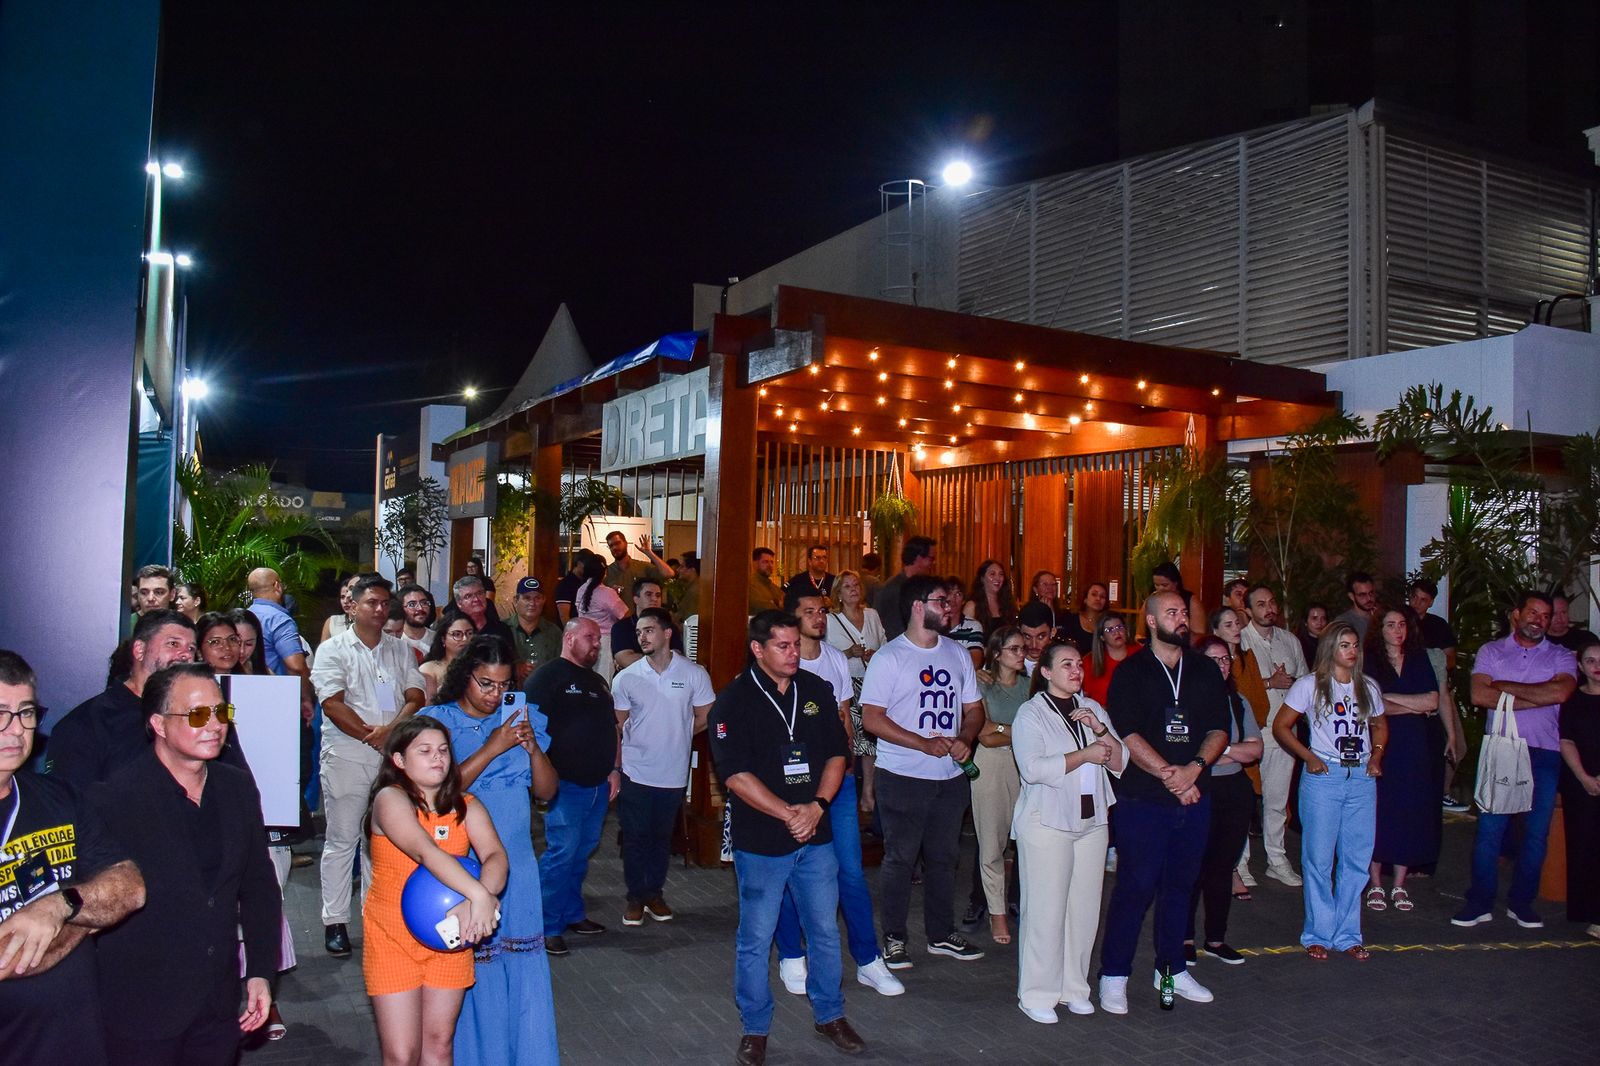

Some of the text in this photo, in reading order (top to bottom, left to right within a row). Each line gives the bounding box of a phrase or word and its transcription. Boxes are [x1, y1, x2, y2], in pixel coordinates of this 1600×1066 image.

[919, 665, 951, 687] do
[919, 686, 956, 708] mi
[919, 711, 954, 729] na
